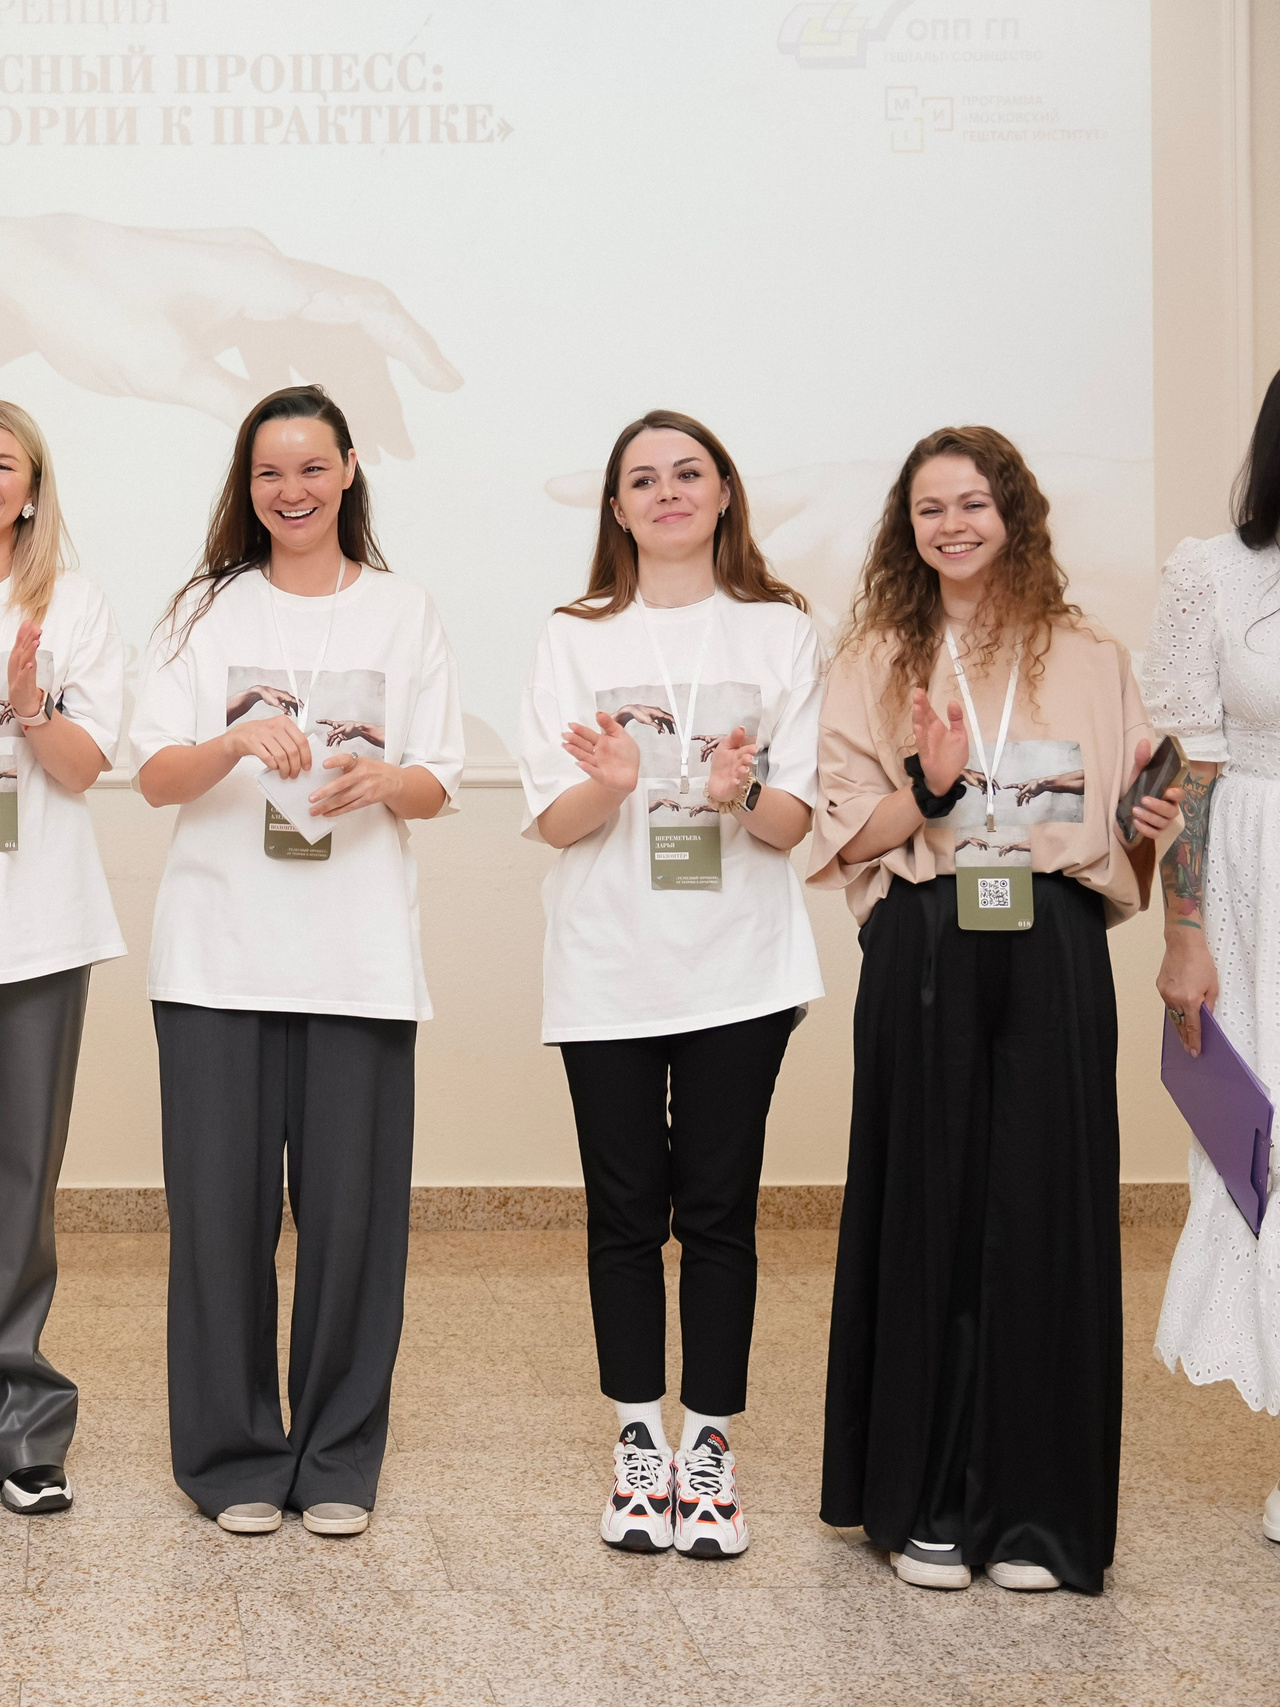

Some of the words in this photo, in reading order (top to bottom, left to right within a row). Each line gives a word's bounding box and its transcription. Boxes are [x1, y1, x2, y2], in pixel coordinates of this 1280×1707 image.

[906, 18, 972, 42] ОПП
[985, 17, 1021, 41] ГП
[173, 51, 445, 102] ПРОЦЕСС:
[159, 105, 194, 146] К
[210, 103, 515, 146] ПРАКТИКЕ»
